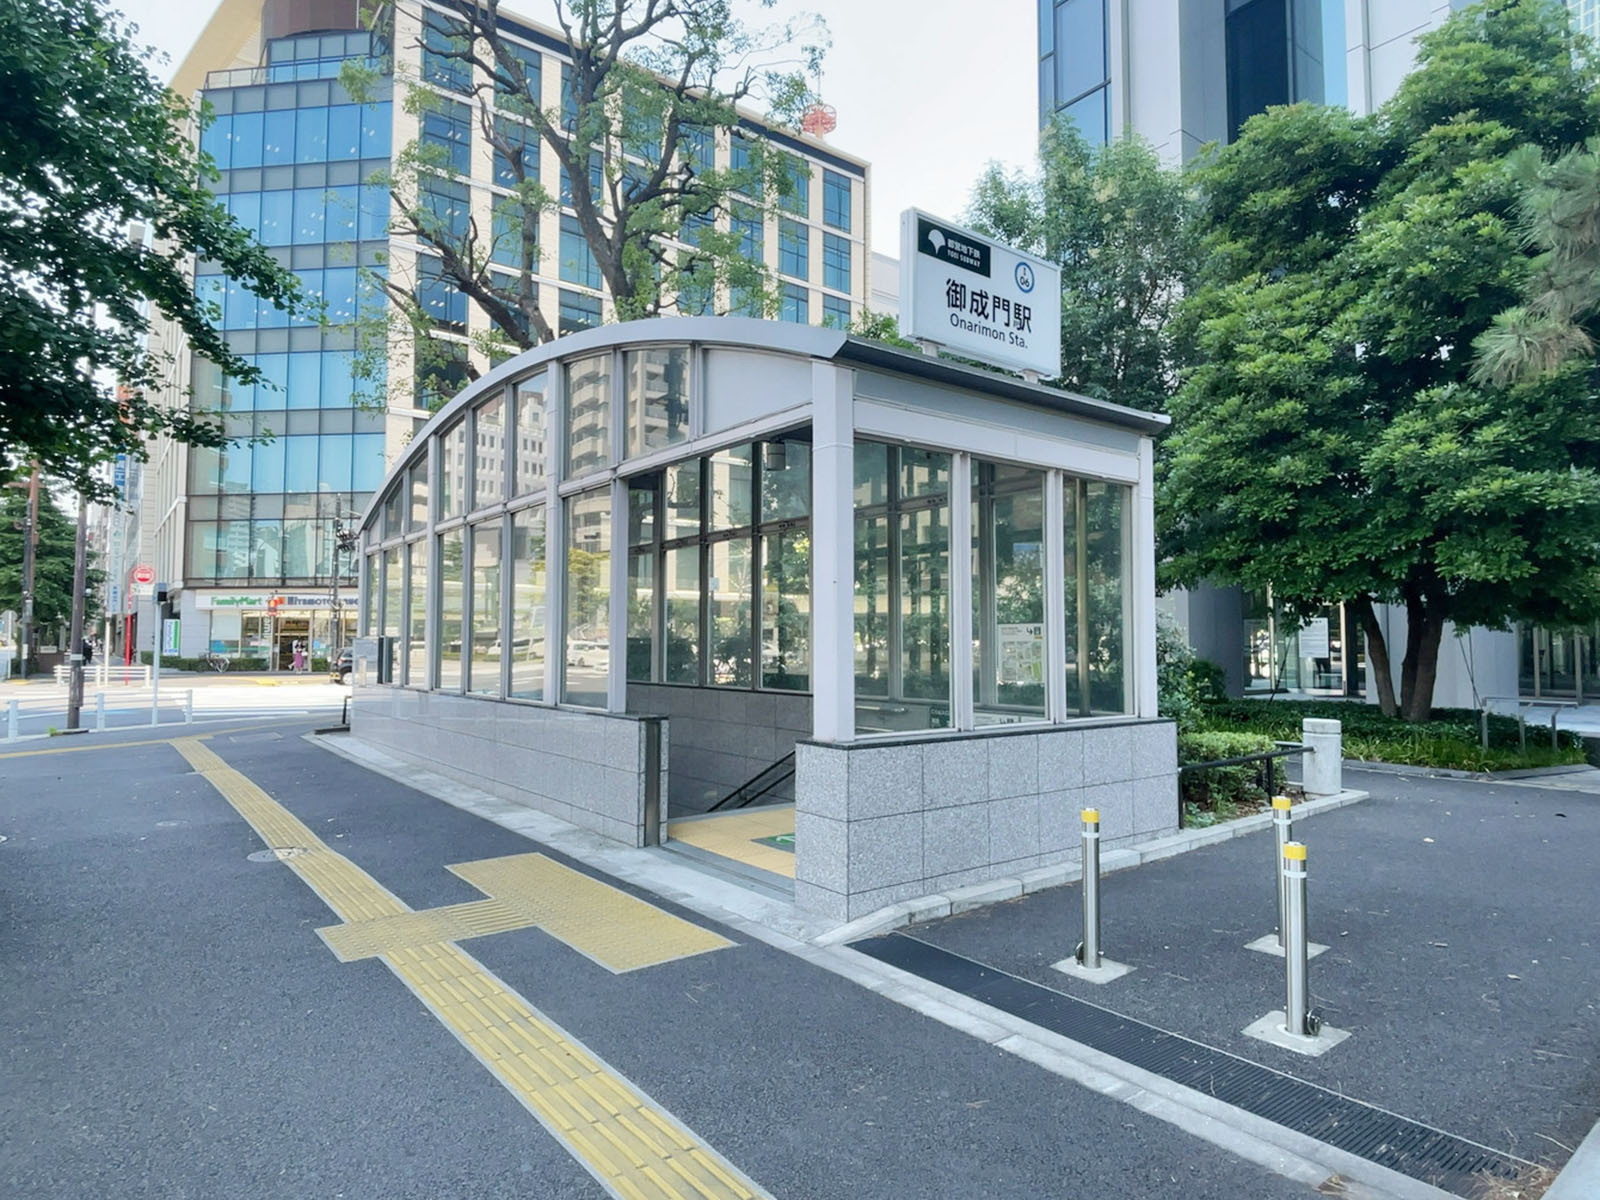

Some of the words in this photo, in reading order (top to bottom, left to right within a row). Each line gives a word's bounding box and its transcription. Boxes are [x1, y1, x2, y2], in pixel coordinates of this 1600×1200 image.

[1019, 276, 1030, 288] 06
[945, 278, 1032, 333] 御成門駅
[950, 312, 1006, 342] Onarimon
[1009, 331, 1028, 349] Sta.
[211, 596, 262, 607] FamilyMart
